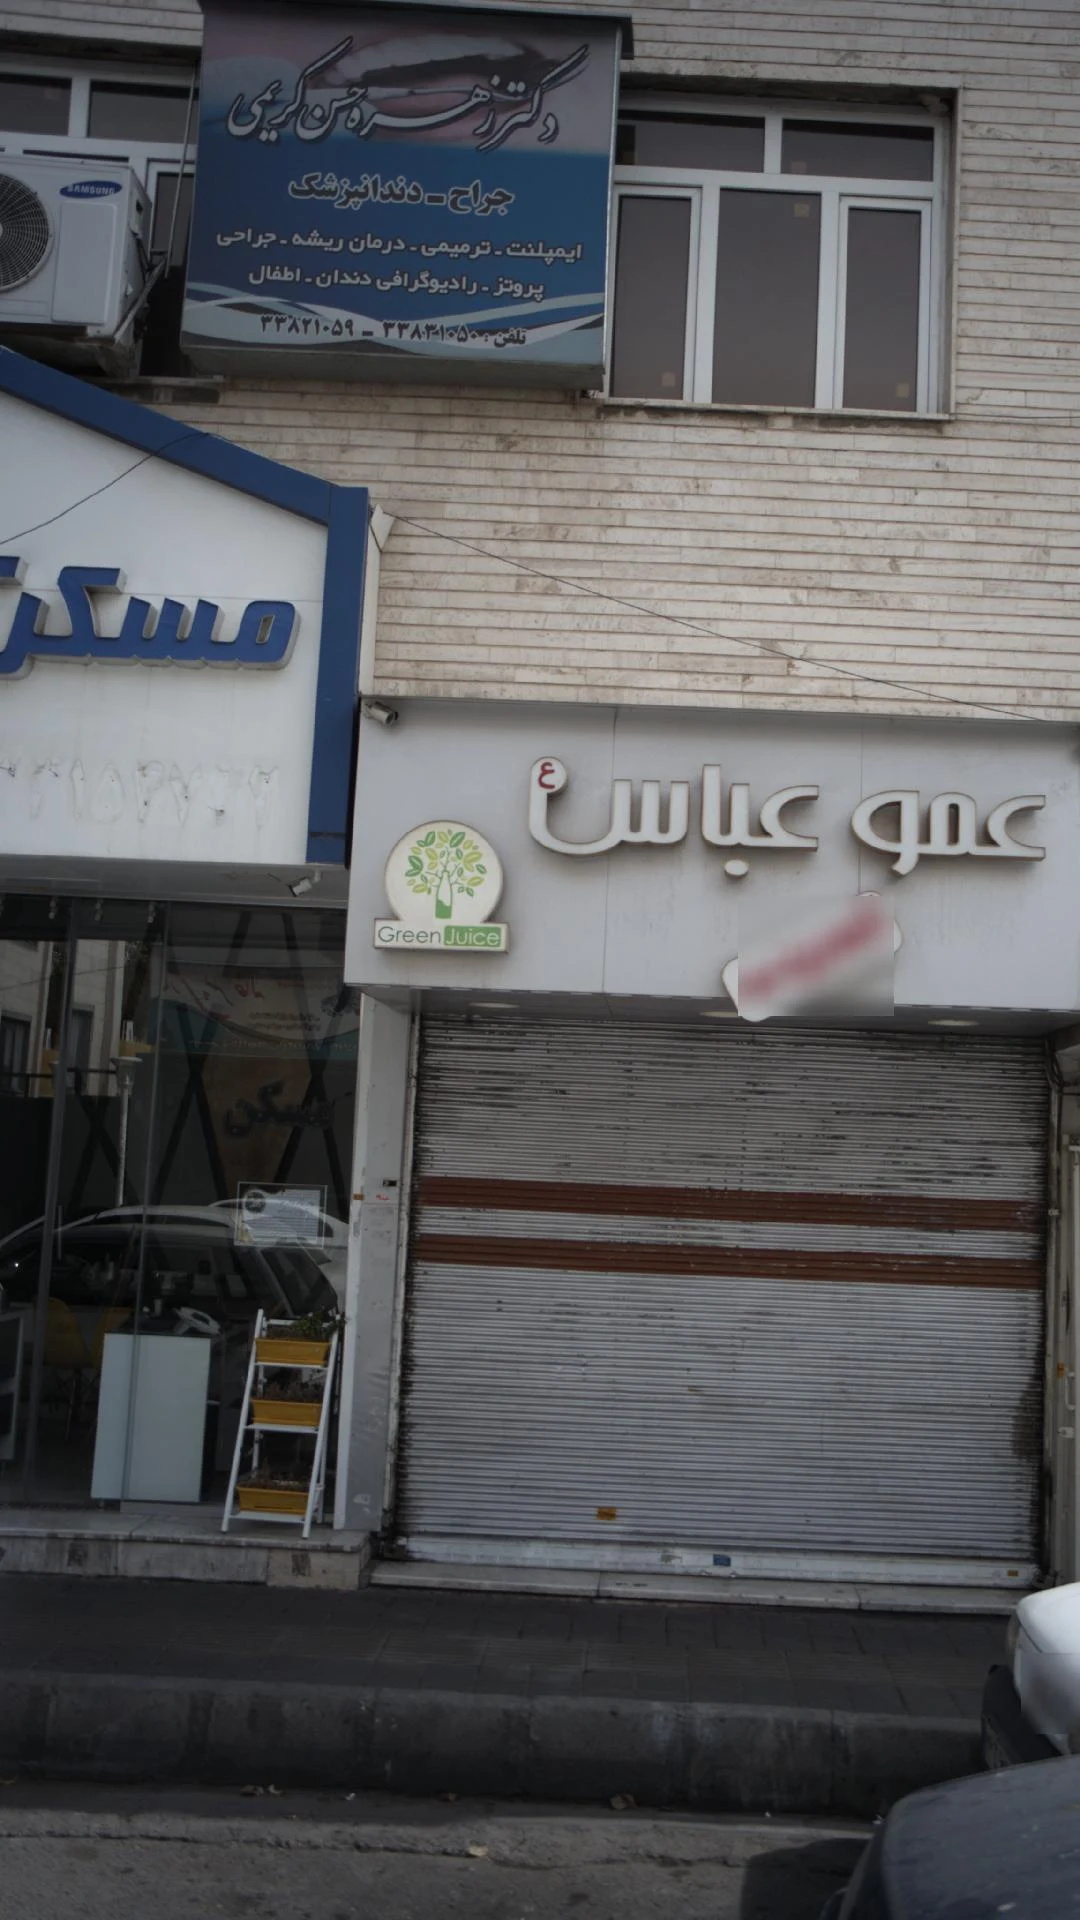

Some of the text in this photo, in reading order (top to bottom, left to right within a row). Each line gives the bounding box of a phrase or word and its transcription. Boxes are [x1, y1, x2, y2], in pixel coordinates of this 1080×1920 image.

[226, 35, 354, 144] کریمی
[346, 73, 500, 137] زهره
[477, 44, 590, 152] دکتر
[66, 184, 115, 195] SAMSUNG
[288, 172, 515, 215] جراح دندانپزشک
[216, 228, 583, 265] ایمپلنت ترمیمی درمان ریشه جراحی
[248, 265, 544, 301] پروتز رادیوگرافی دندان اطفال
[528, 756, 820, 879] عباس
[851, 789, 1047, 876] عمو
[377, 925, 500, 946] Green Juice
